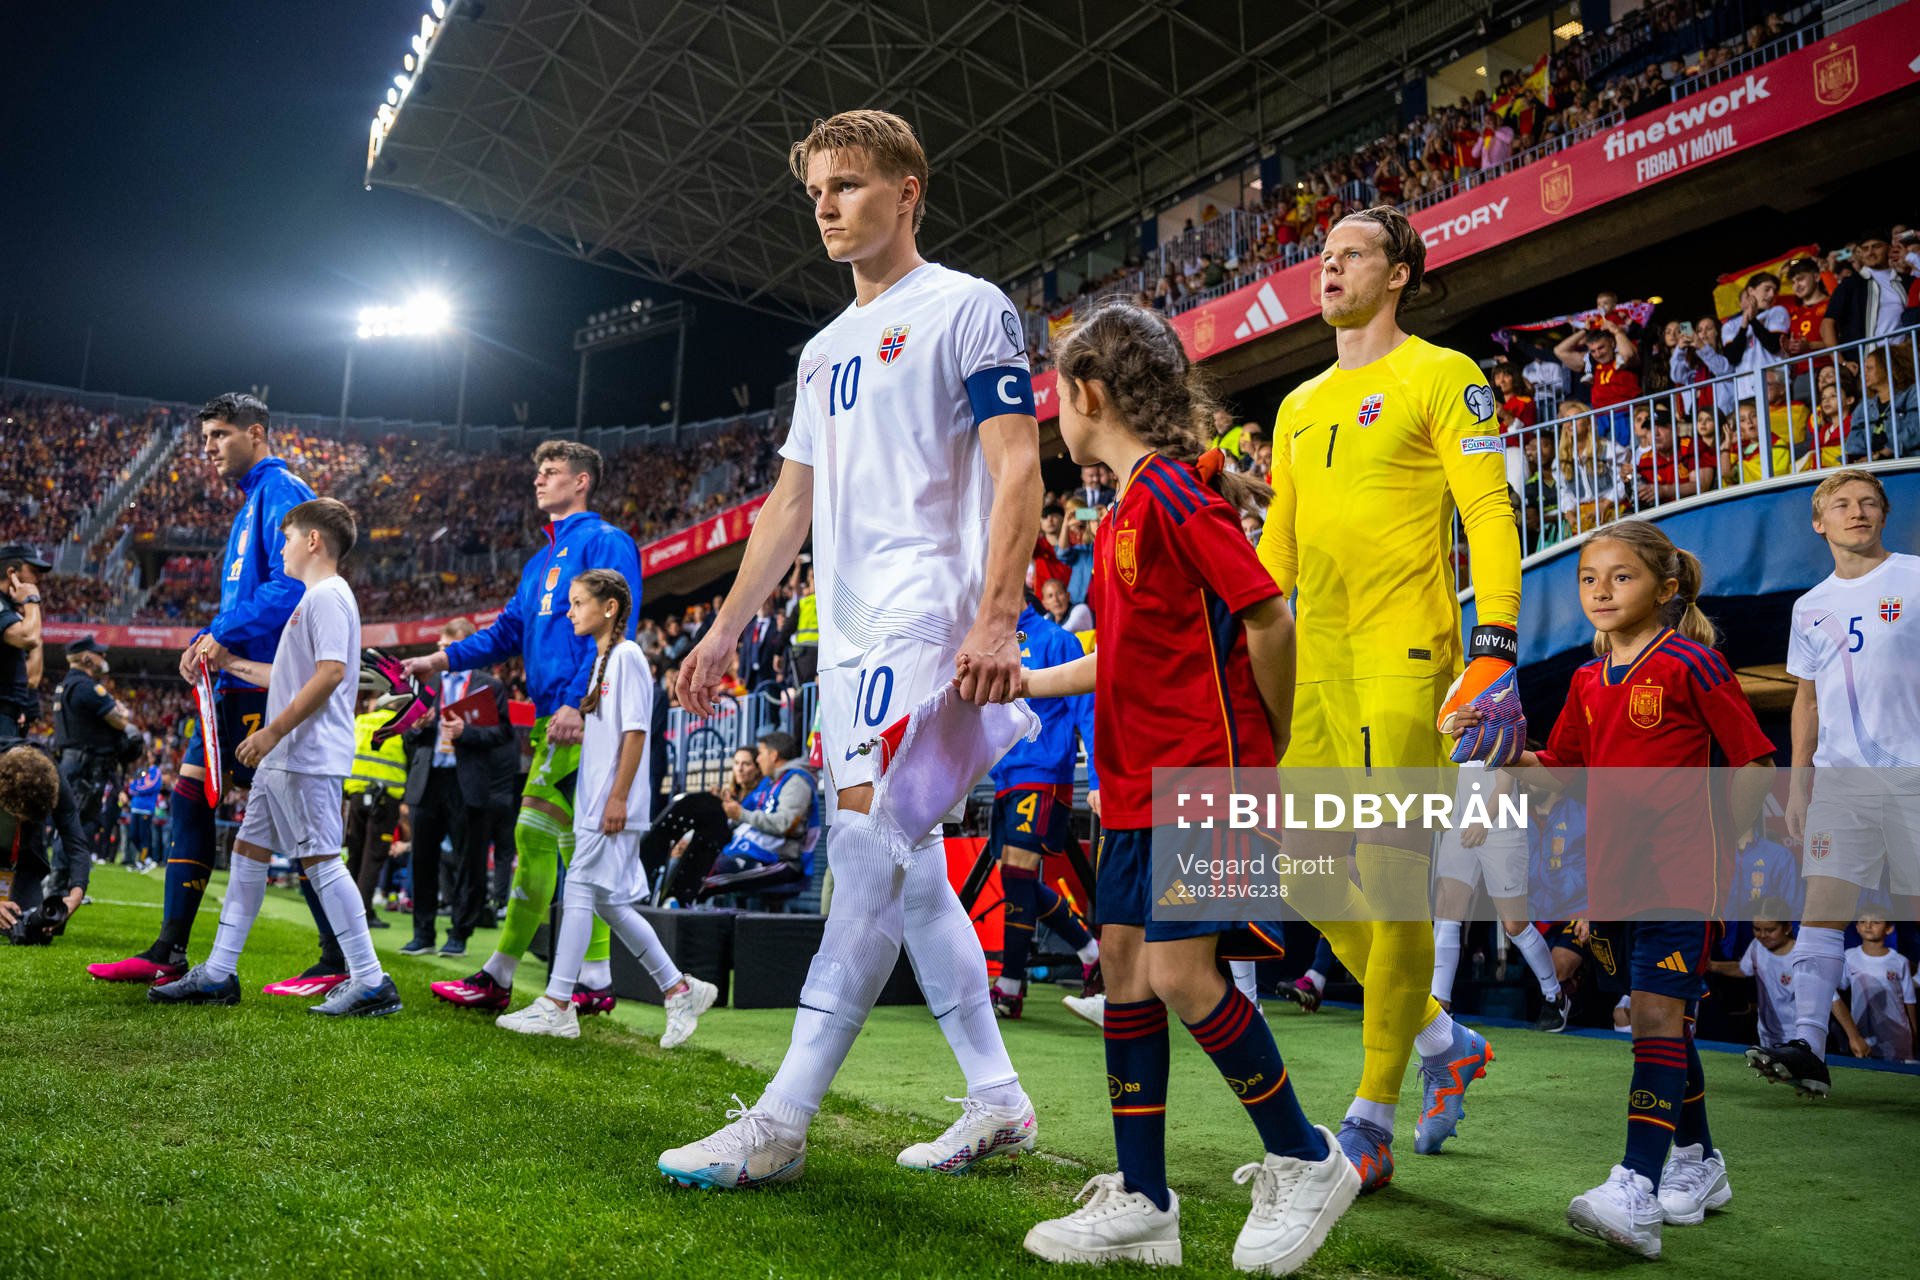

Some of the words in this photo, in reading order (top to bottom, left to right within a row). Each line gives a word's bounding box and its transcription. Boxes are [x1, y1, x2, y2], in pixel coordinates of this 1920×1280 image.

[1603, 75, 1771, 162] finetwork
[1636, 147, 1678, 183] FIBRA
[1678, 141, 1688, 166] Y
[1690, 124, 1737, 162] MÓVIL
[1801, 320, 1811, 336] 9
[829, 355, 861, 416] 10
[997, 375, 1022, 405] C
[1326, 424, 1339, 468] 1
[1849, 616, 1864, 653] 5
[853, 665, 894, 728] 10
[242, 713, 261, 737] 7
[1360, 726, 1372, 777] 1
[1016, 792, 1038, 822] 4
